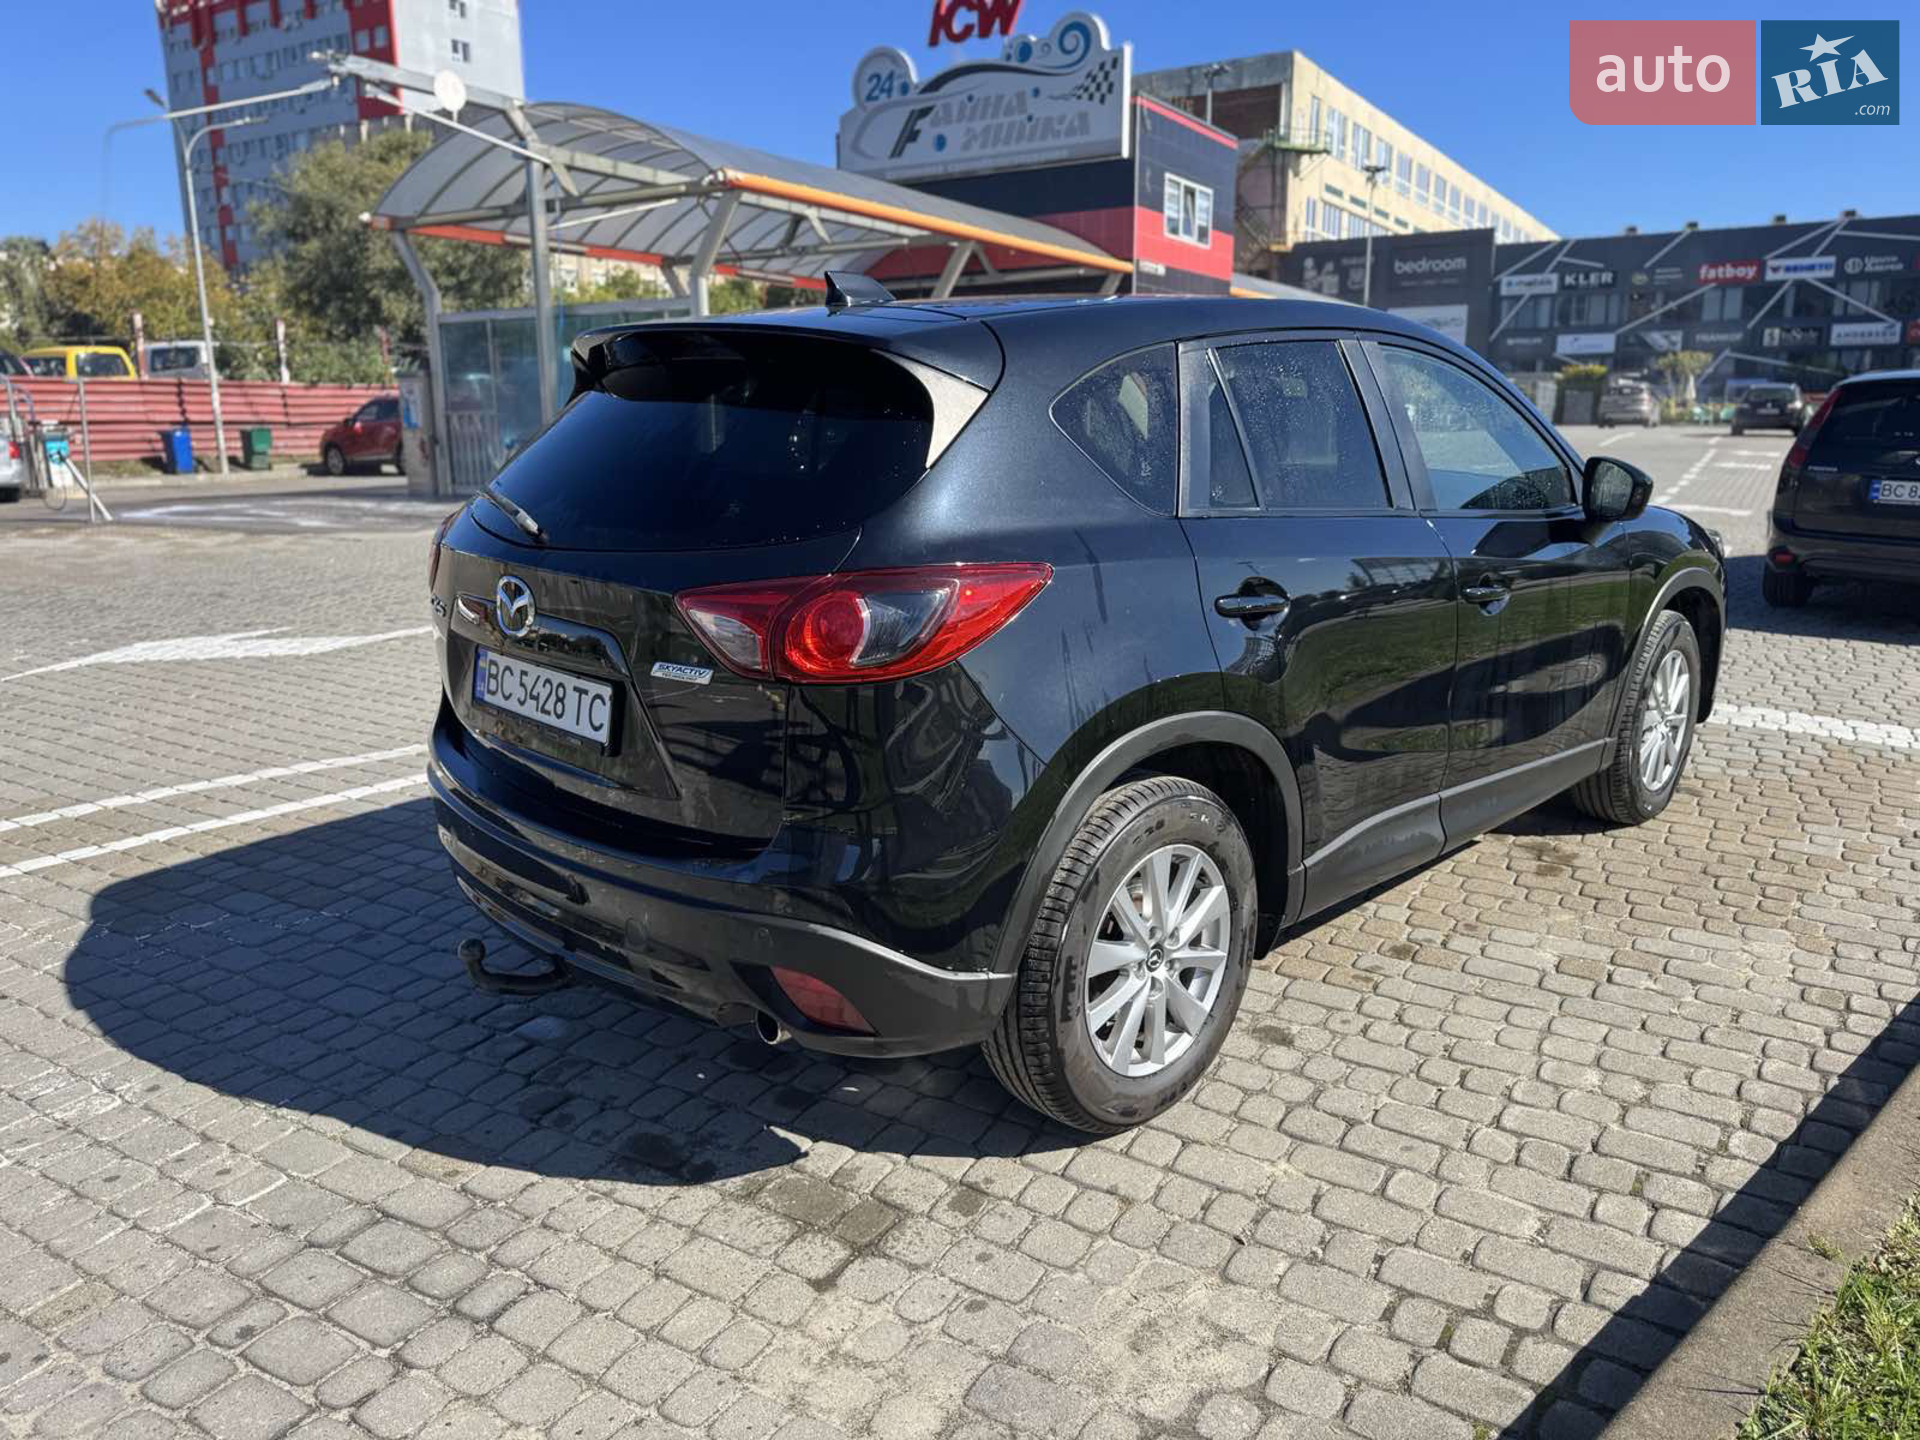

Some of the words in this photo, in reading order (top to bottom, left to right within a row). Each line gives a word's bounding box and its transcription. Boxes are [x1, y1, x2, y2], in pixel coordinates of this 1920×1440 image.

[866, 72, 896, 102] 24
[1394, 256, 1467, 274] bedroom
[1699, 262, 1757, 281] fatboy
[1564, 271, 1613, 286] KLER
[1881, 483, 1904, 499] BC
[659, 663, 709, 678] SKYACTIV
[486, 659, 514, 701] BC
[517, 669, 567, 720] 5428
[573, 685, 607, 732] TC
